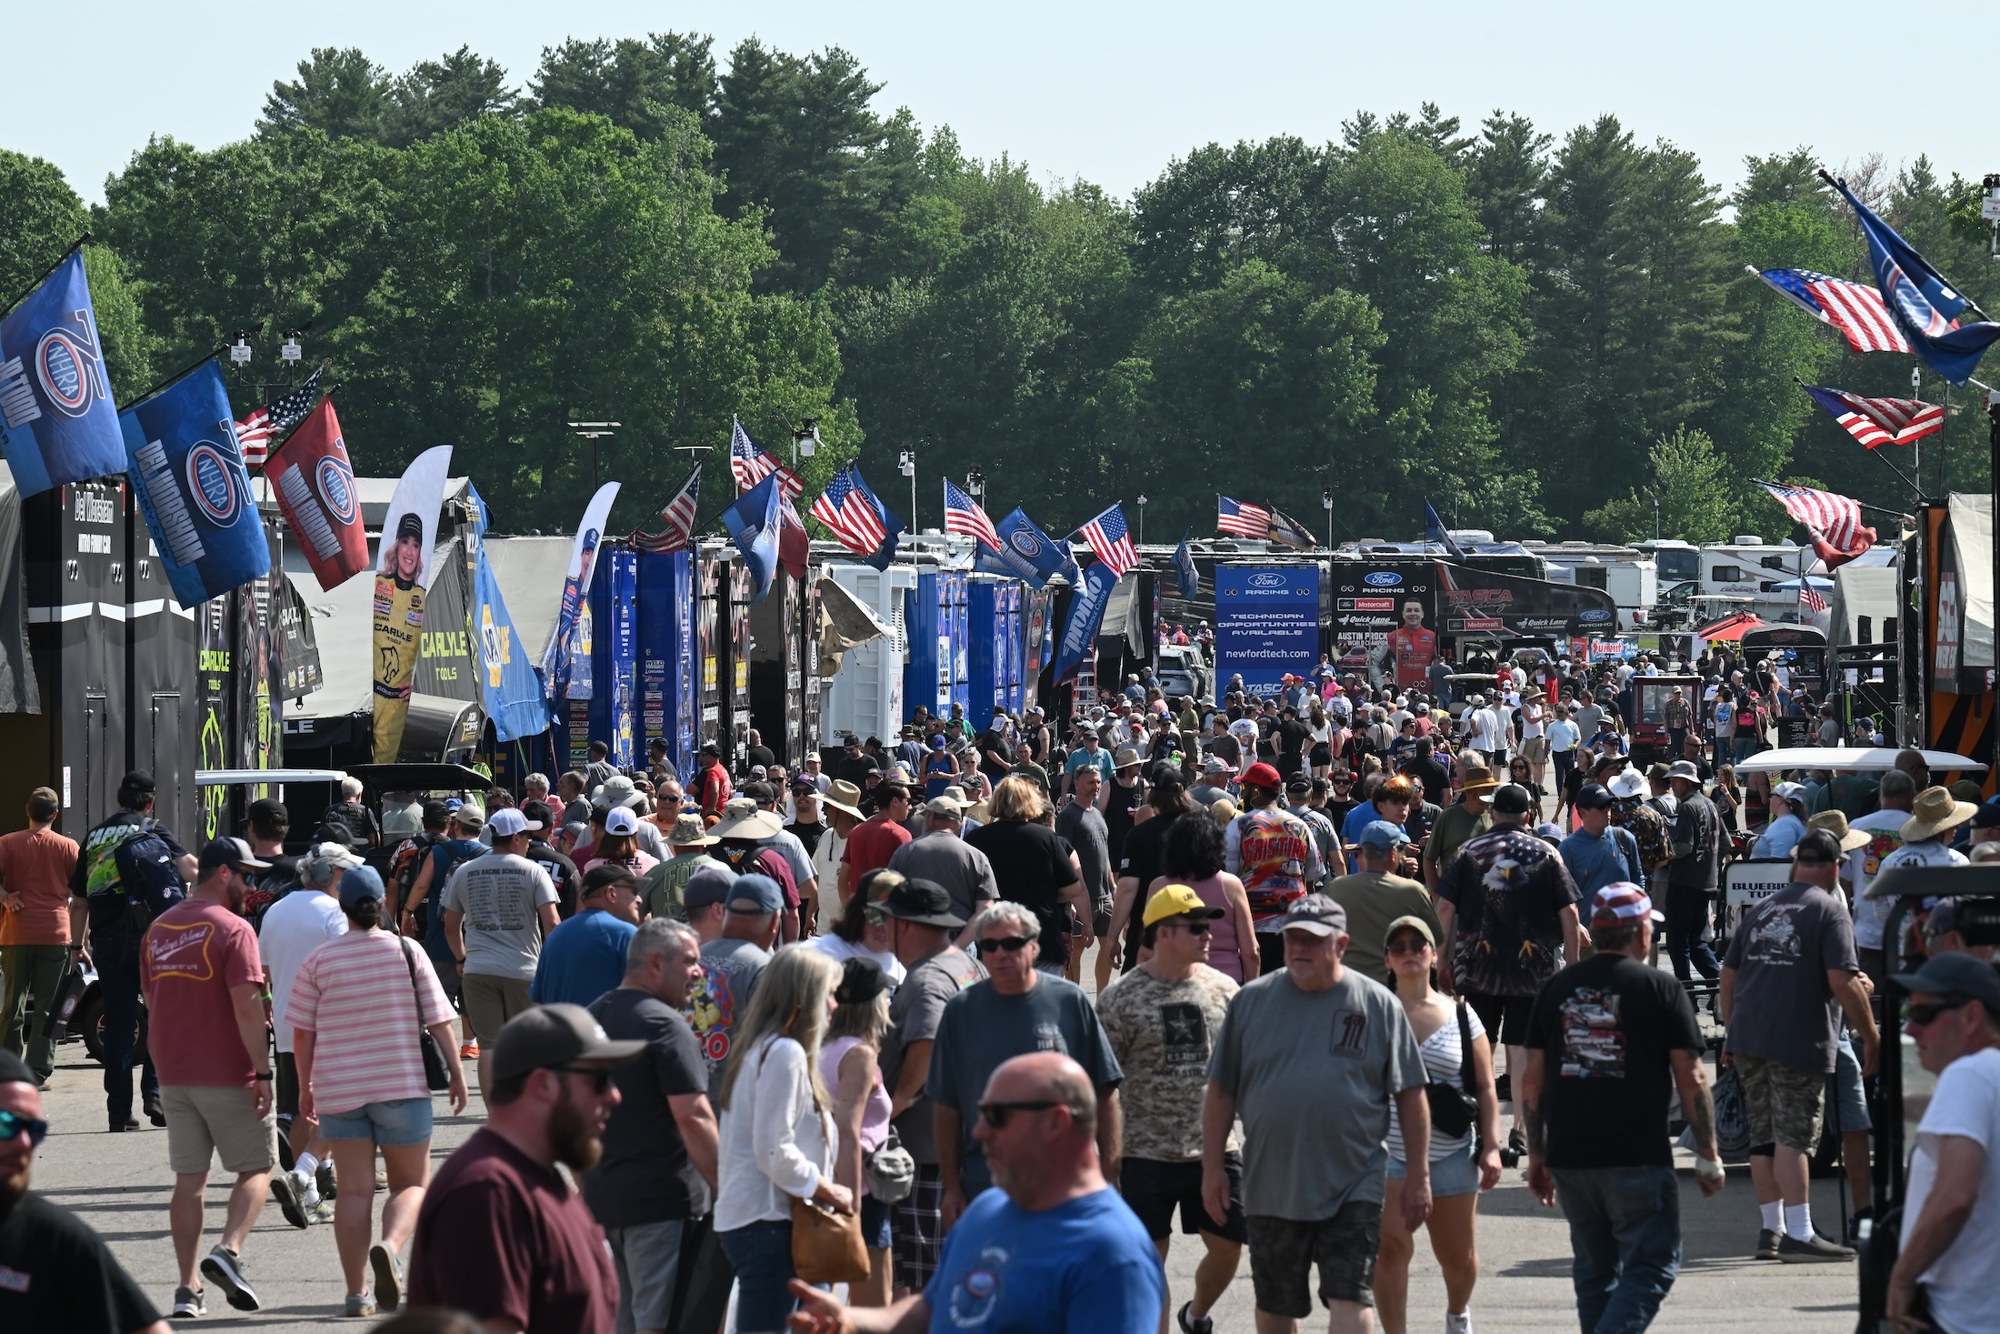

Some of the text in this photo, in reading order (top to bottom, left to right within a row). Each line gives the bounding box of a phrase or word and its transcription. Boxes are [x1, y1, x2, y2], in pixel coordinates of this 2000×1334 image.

[48, 345, 79, 397] NHRA
[0, 373, 42, 429] TODD
[199, 457, 228, 508] NHRA
[325, 469, 349, 511] NHRA
[131, 467, 154, 520] FUNNY
[153, 525, 168, 558] CAR
[134, 439, 206, 567] DEL WORSHAM
[295, 498, 342, 562] GORDON
[1255, 574, 1279, 586] Ford
[1371, 574, 1395, 584] Ford
[1448, 588, 1514, 603] TASCA
[1349, 615, 1391, 623] Quick Lane
[1527, 618, 1568, 626] Quick Lane
[1585, 610, 1606, 621] Ford
[375, 623, 413, 642] CARLYLE
[1337, 632, 1388, 640] AUSTIN PROCK
[421, 632, 467, 658] CARLYLE
[1226, 649, 1310, 658] newfordtech.com
[200, 650, 230, 673] CARLYLE
[436, 667, 458, 681] TOOLS
